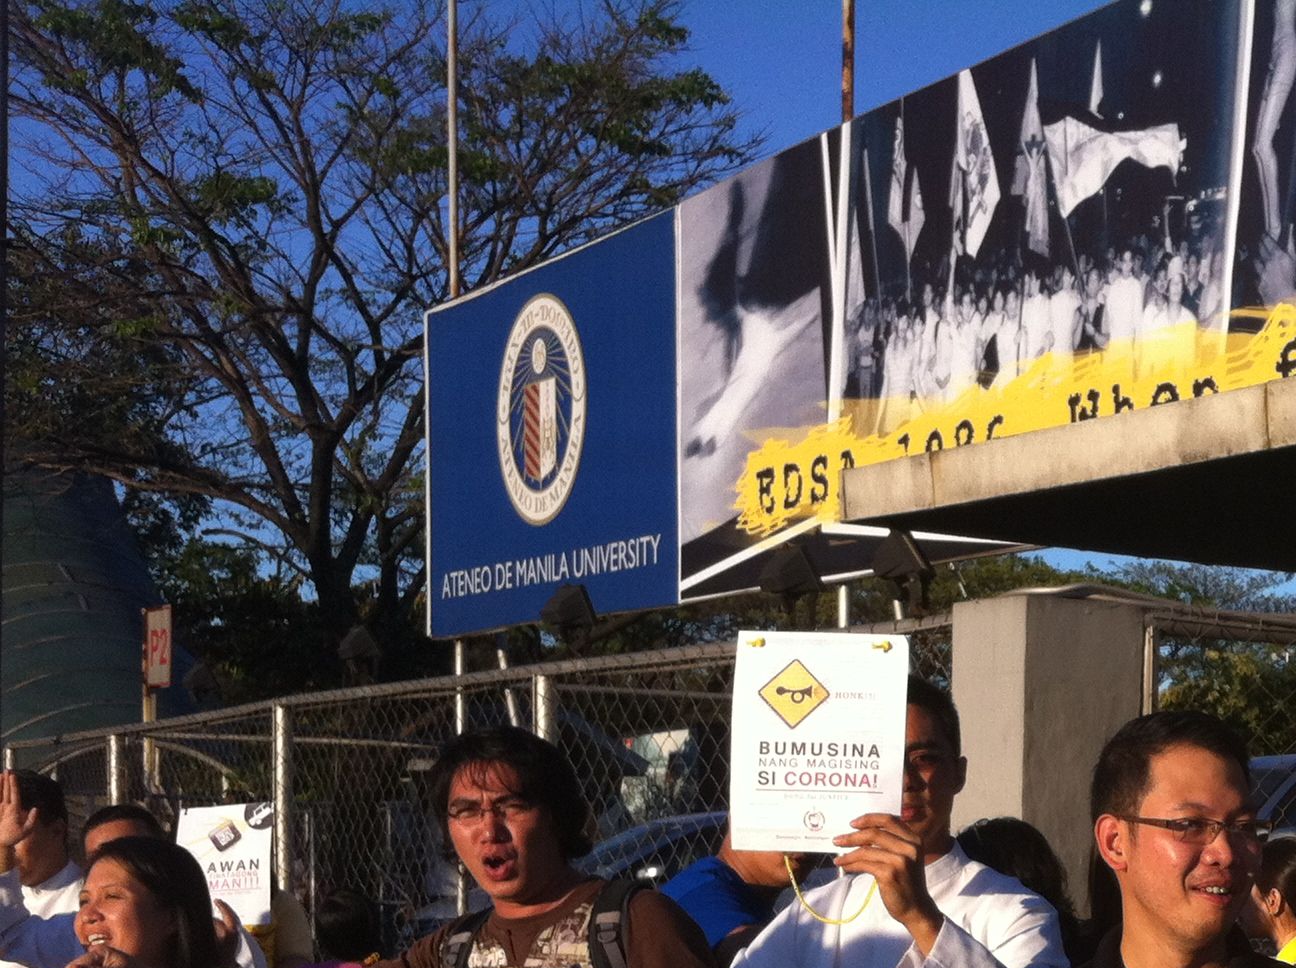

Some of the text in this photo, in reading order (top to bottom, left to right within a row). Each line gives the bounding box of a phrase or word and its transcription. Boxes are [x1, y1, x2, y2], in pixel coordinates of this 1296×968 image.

[442, 533, 661, 599] ATENEO DE MANILA UNIVERSITY
[151, 628, 168, 666] P2
[759, 741, 880, 758] BUMUSINA
[758, 758, 880, 770] NANG MAGISING
[758, 771, 878, 789] SI CORONA!
[207, 859, 260, 874] AWAN
